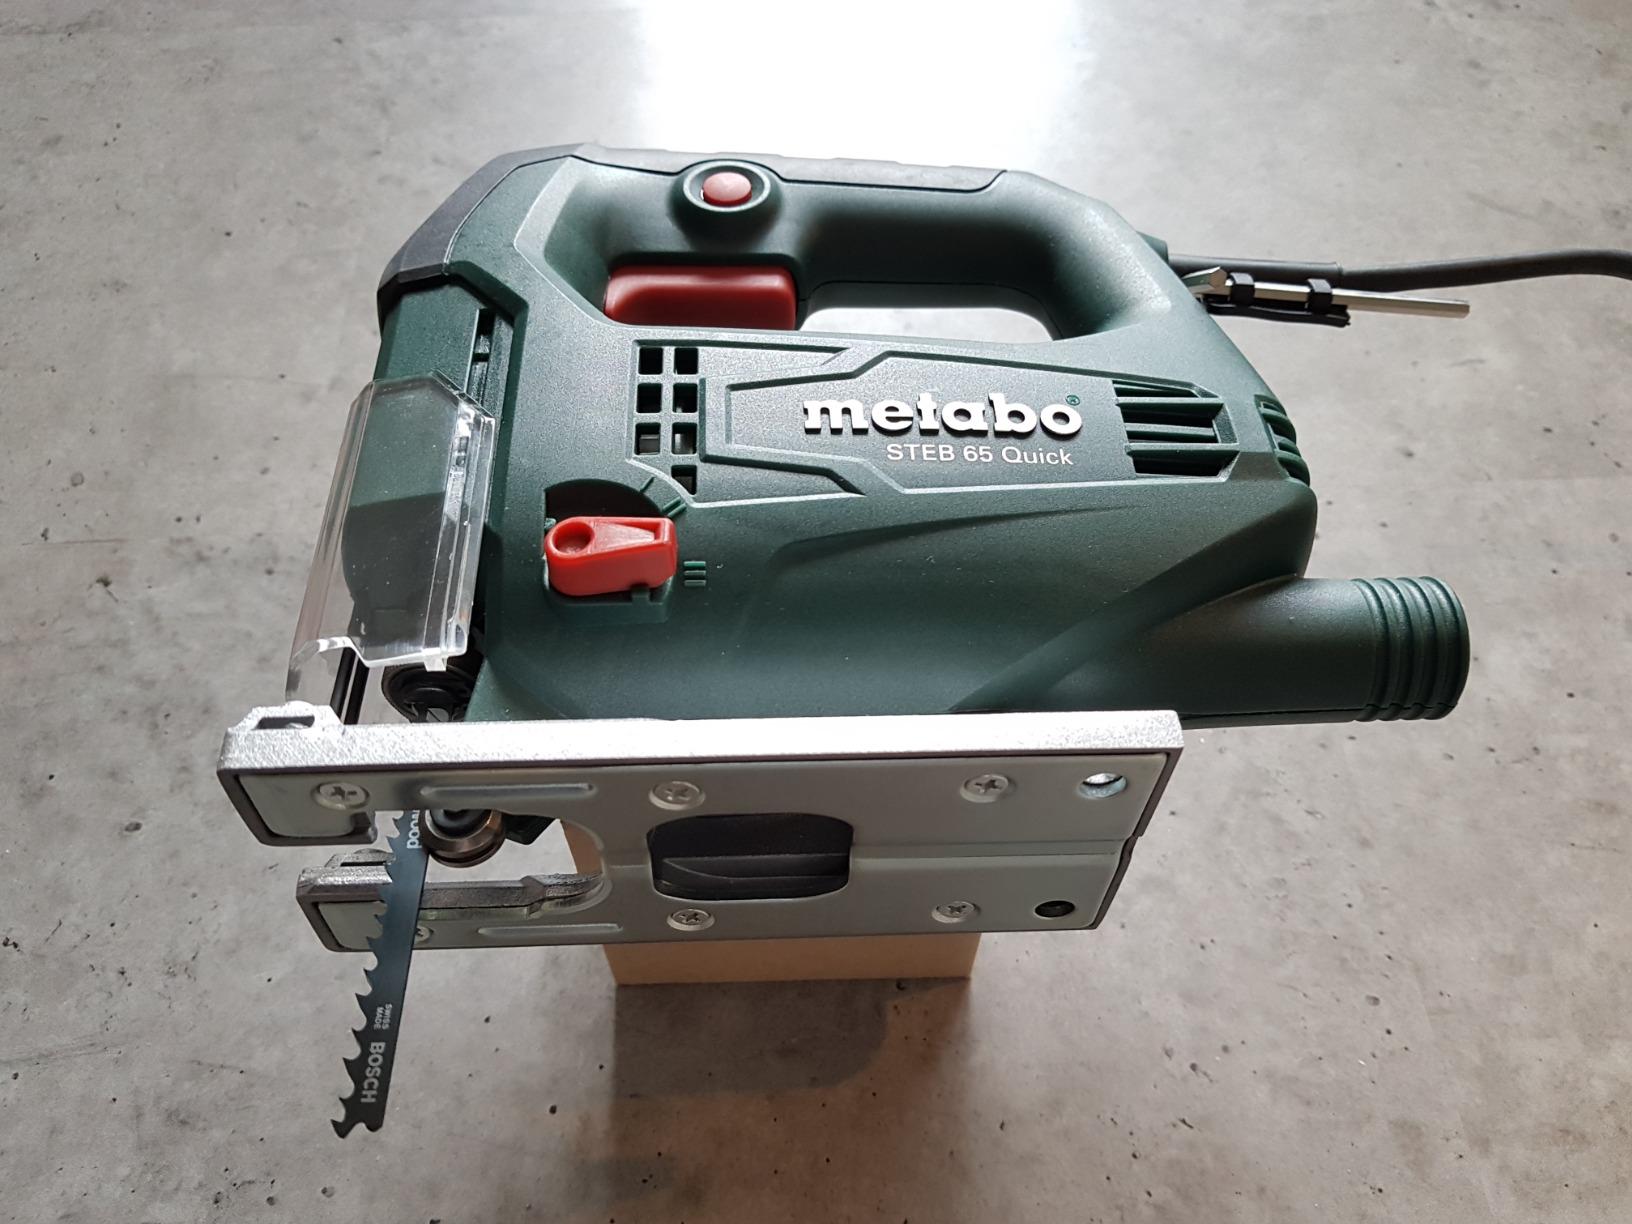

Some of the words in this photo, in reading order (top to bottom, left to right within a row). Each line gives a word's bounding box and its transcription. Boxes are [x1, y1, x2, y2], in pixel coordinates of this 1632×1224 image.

[803, 392, 1082, 438] metabo
[886, 442, 955, 462] STEB
[963, 445, 994, 463] 65
[1001, 446, 1074, 466] Quick
[360, 1041, 386, 1103] BOSCH
